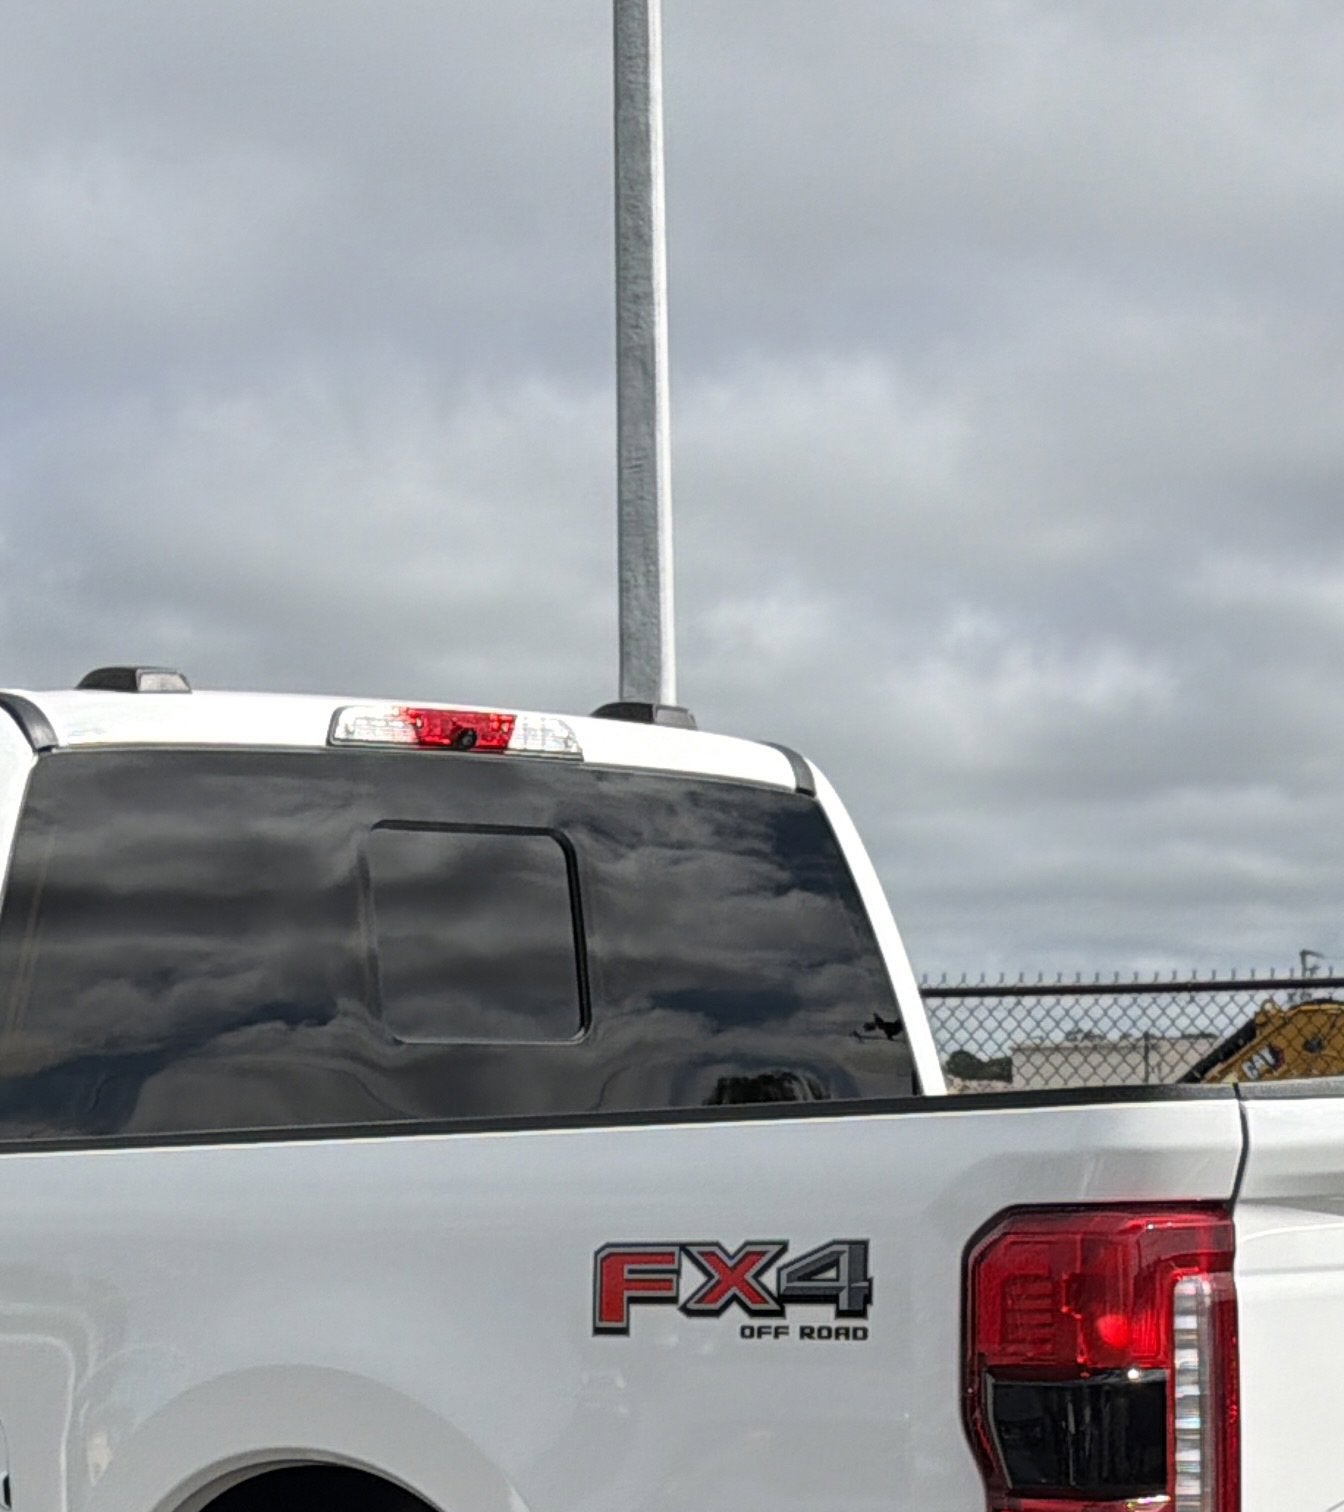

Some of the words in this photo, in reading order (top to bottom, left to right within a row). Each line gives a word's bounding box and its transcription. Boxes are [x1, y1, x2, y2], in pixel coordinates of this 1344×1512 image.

[593, 1239, 873, 1337] FX4
[740, 1325, 790, 1339] OFF
[799, 1325, 869, 1341] ROAD
